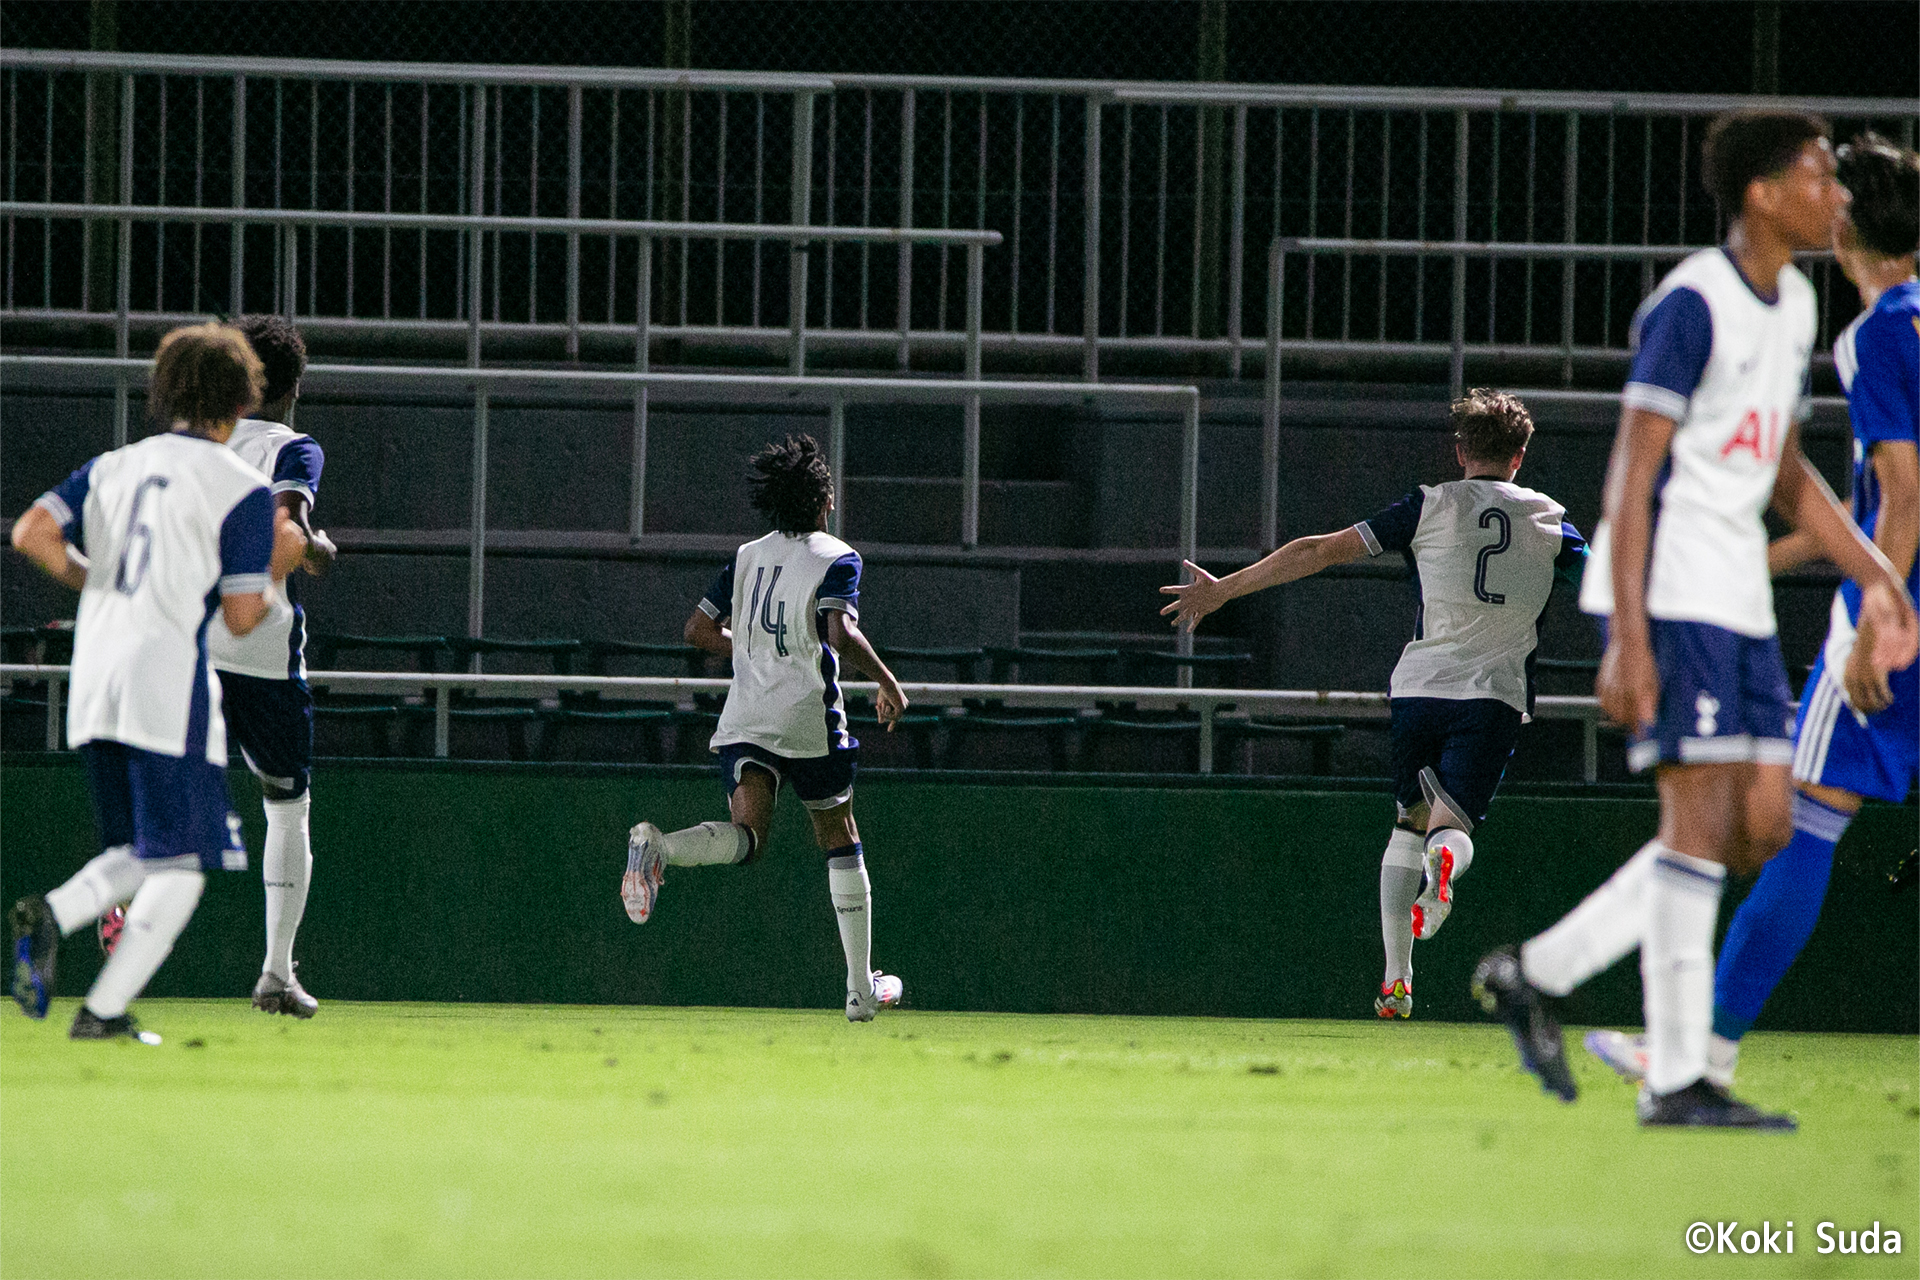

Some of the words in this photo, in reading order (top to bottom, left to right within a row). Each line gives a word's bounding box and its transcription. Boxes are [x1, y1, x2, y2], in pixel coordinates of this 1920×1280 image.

[115, 475, 169, 596] 6
[1474, 507, 1511, 605] 2
[748, 565, 790, 660] 14
[836, 905, 863, 915] Spurs
